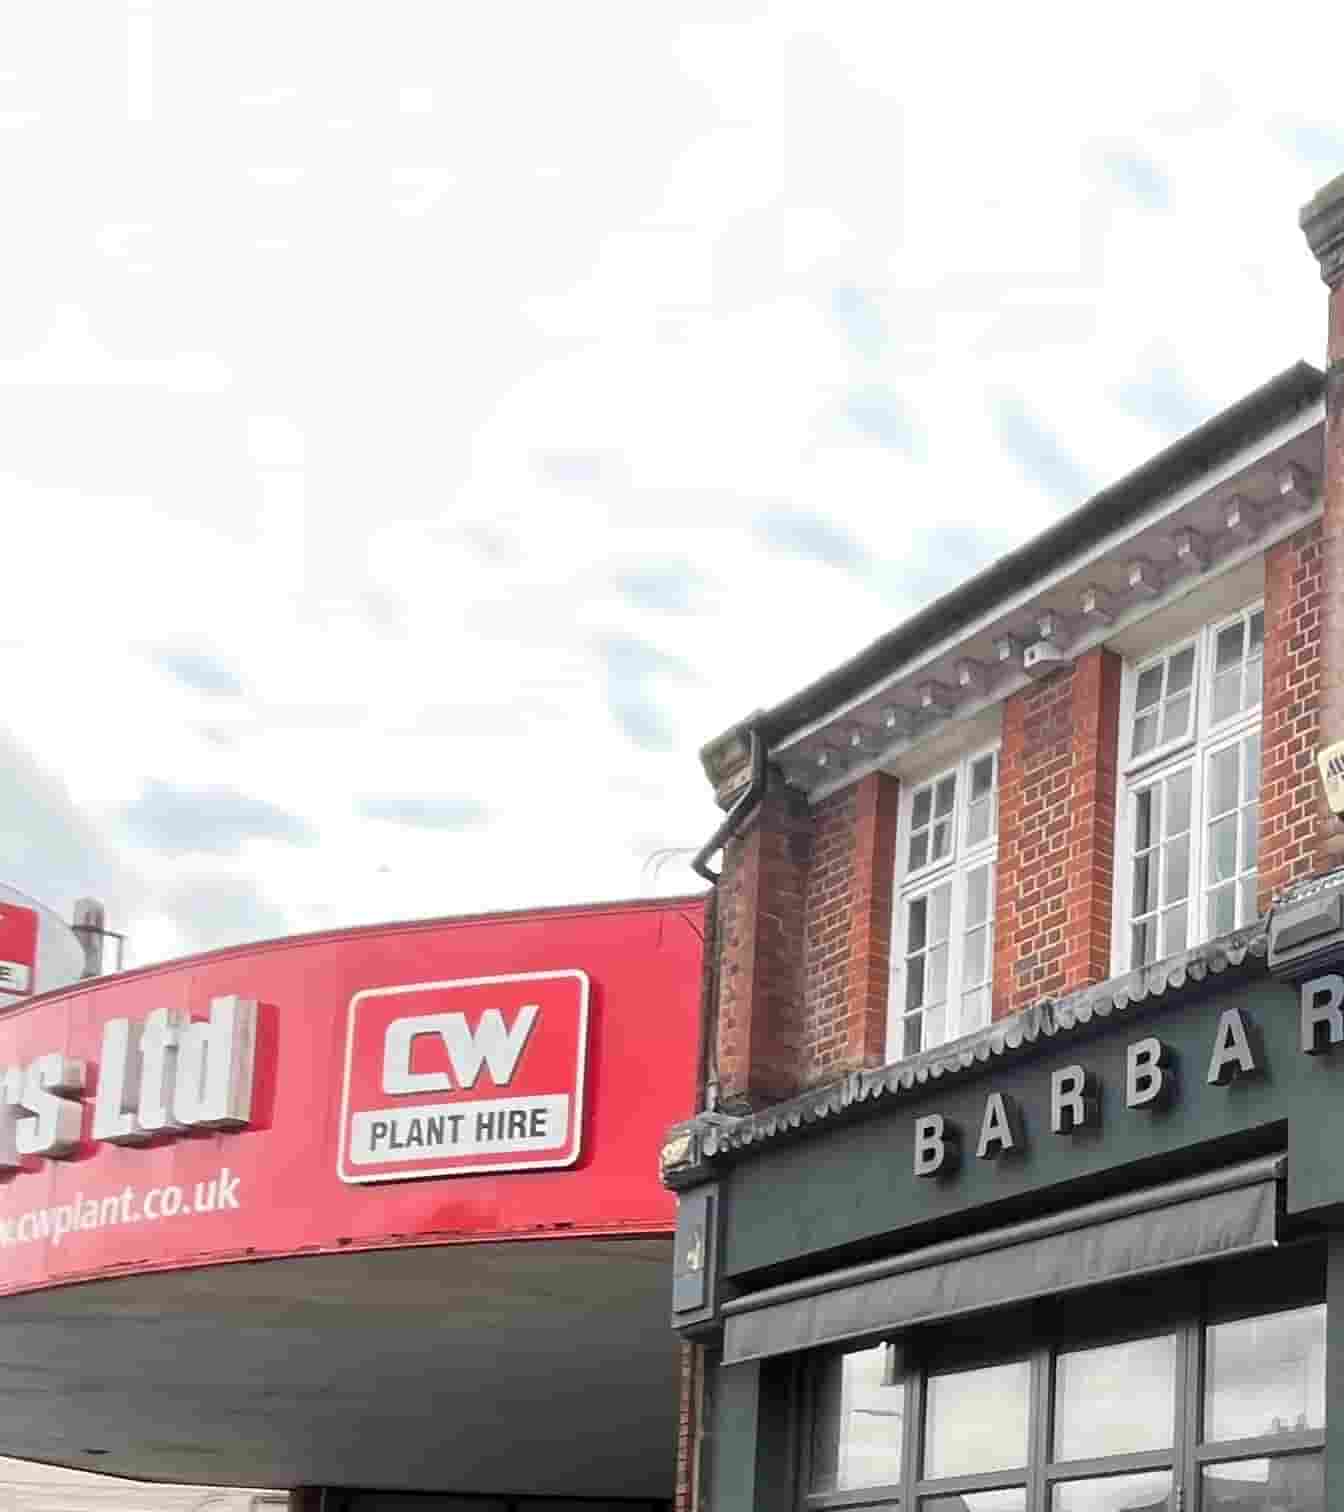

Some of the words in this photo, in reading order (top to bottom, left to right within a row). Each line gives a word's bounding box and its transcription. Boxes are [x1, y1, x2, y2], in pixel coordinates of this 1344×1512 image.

[93, 994, 256, 1142] Ltd
[383, 1003, 540, 1095] CW
[370, 1114, 465, 1151] PLANT
[475, 1107, 548, 1143] HIRE
